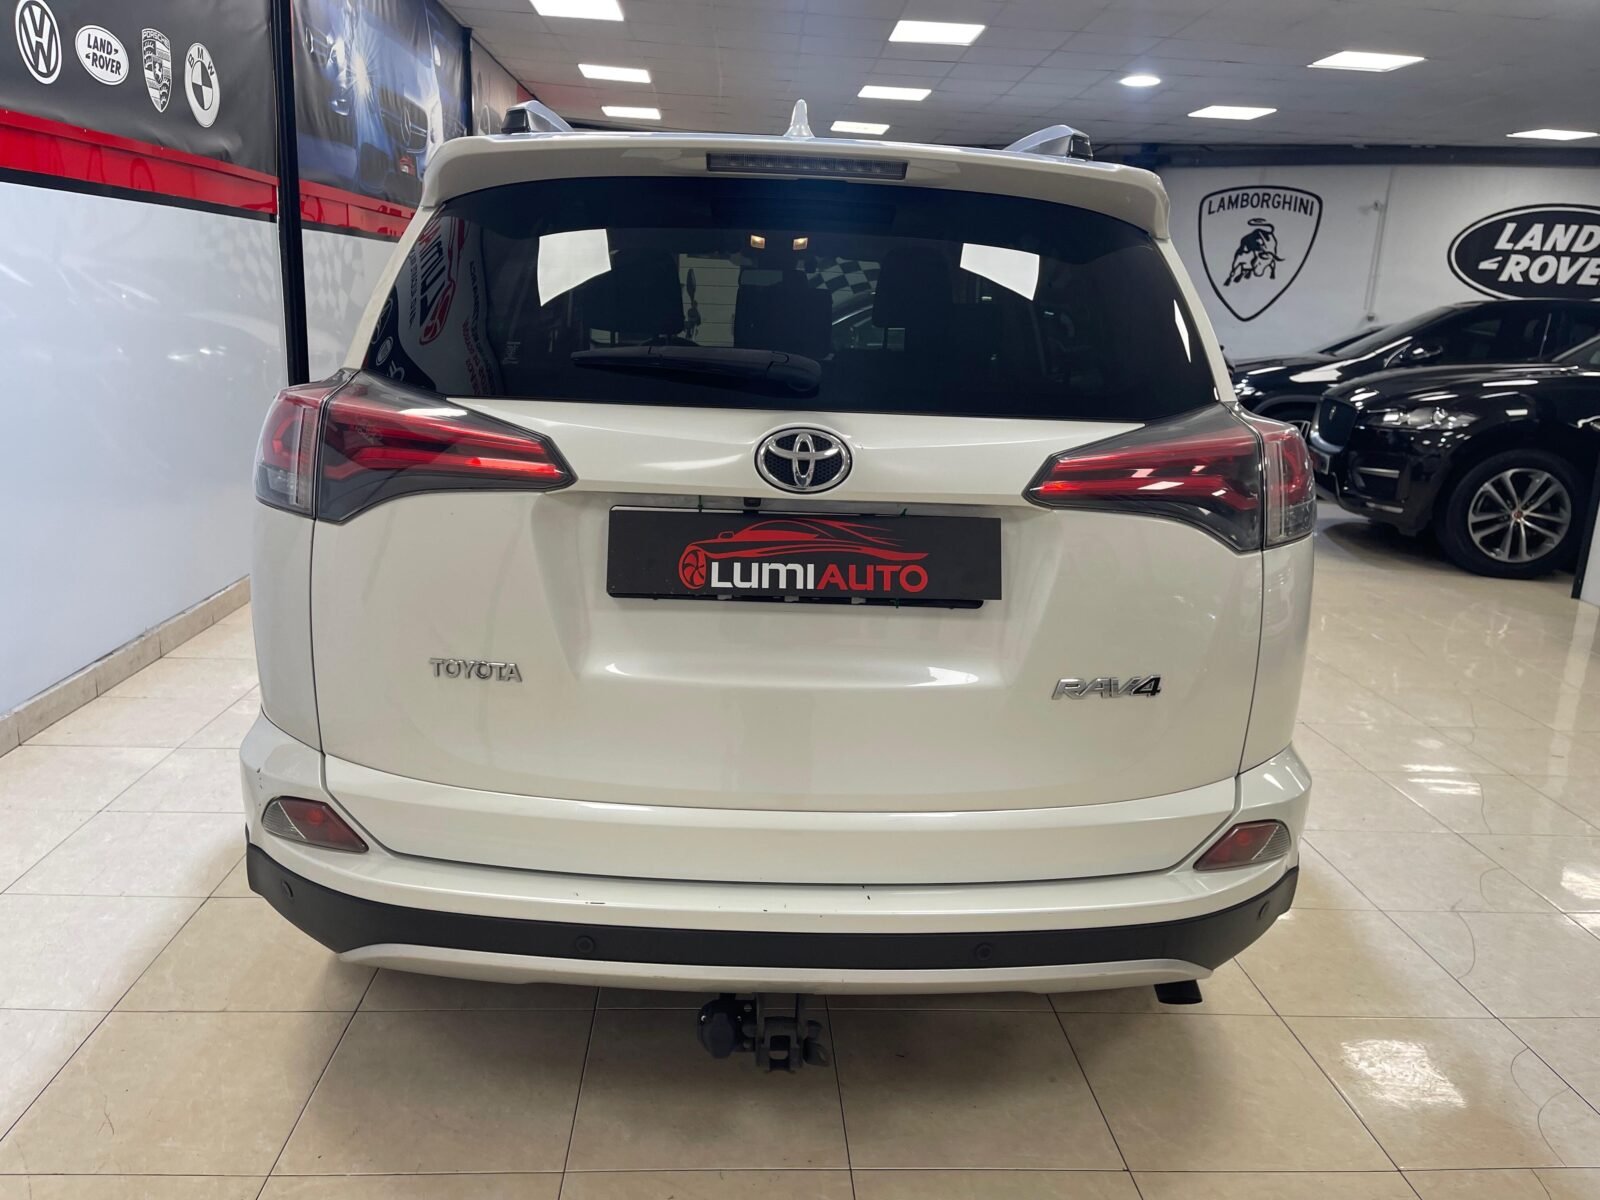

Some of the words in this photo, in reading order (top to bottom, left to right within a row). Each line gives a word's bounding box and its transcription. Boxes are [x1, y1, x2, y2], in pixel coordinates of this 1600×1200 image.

[87, 33, 113, 55] LAND
[91, 51, 121, 76] ROVER
[188, 46, 215, 76] BMW
[1207, 192, 1315, 216] LAMBORGHINI
[1494, 222, 1600, 253] LAND
[1498, 254, 1600, 286] ROVE
[429, 657, 523, 683] TOYOTA
[1051, 674, 1161, 700] RAV4
